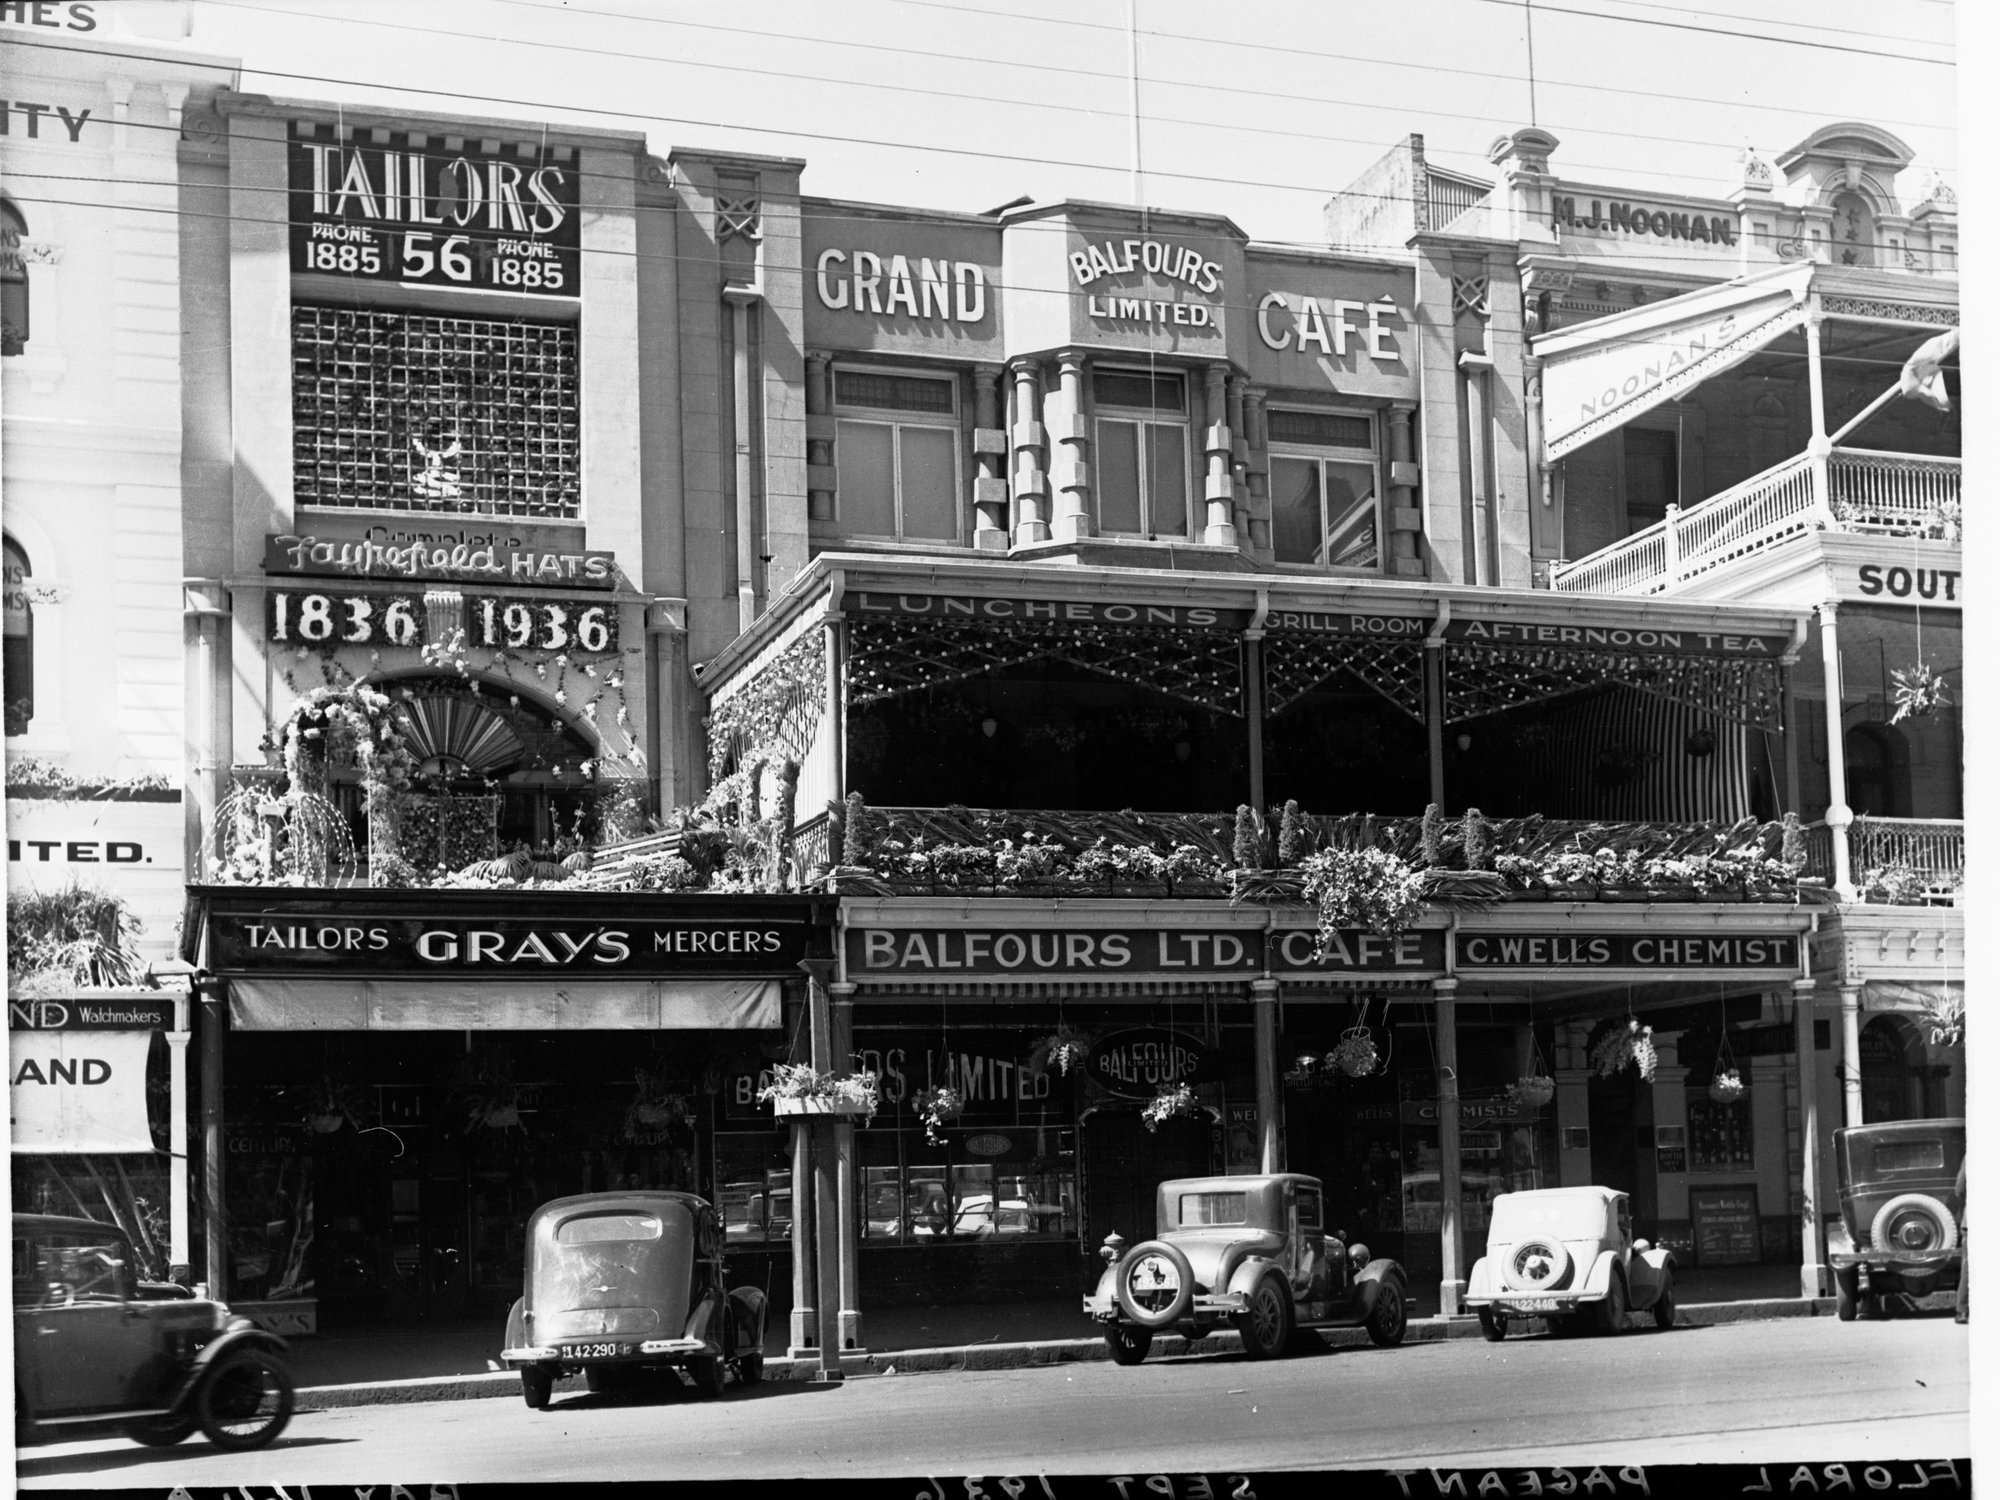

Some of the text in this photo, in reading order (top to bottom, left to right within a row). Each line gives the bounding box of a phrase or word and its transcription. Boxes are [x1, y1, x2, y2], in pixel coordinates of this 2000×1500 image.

[302, 145, 566, 233] TAILORS
[307, 242, 380, 274] 1885
[402, 231, 472, 281] 56
[1069, 240, 1222, 294] BALFOURS
[492, 257, 564, 288] 1885
[816, 248, 985, 323] GRAND
[1089, 296, 1215, 327] LIMITED.
[512, 551, 608, 579] HATS
[1859, 564, 1962, 601] SOUT
[273, 594, 609, 651] 1836 1936
[859, 592, 1219, 626] LUNCHEONS
[1265, 610, 1424, 635] GRILL ROOM
[1464, 621, 1767, 652] AFTERNOON TEA
[9, 840, 152, 863] ITED.
[244, 924, 782, 964] TAILORS GRAY'S MERCERS
[863, 929, 1424, 968] BALFOURS LTD. CAFE
[1632, 938, 1788, 964] CHEMIST
[80, 1006, 161, 1023] Watchmakers
[14, 1059, 113, 1085] AND
[1100, 1043, 1198, 1084] BALFOURS
[1419, 1104, 1518, 1118] CMISTS
